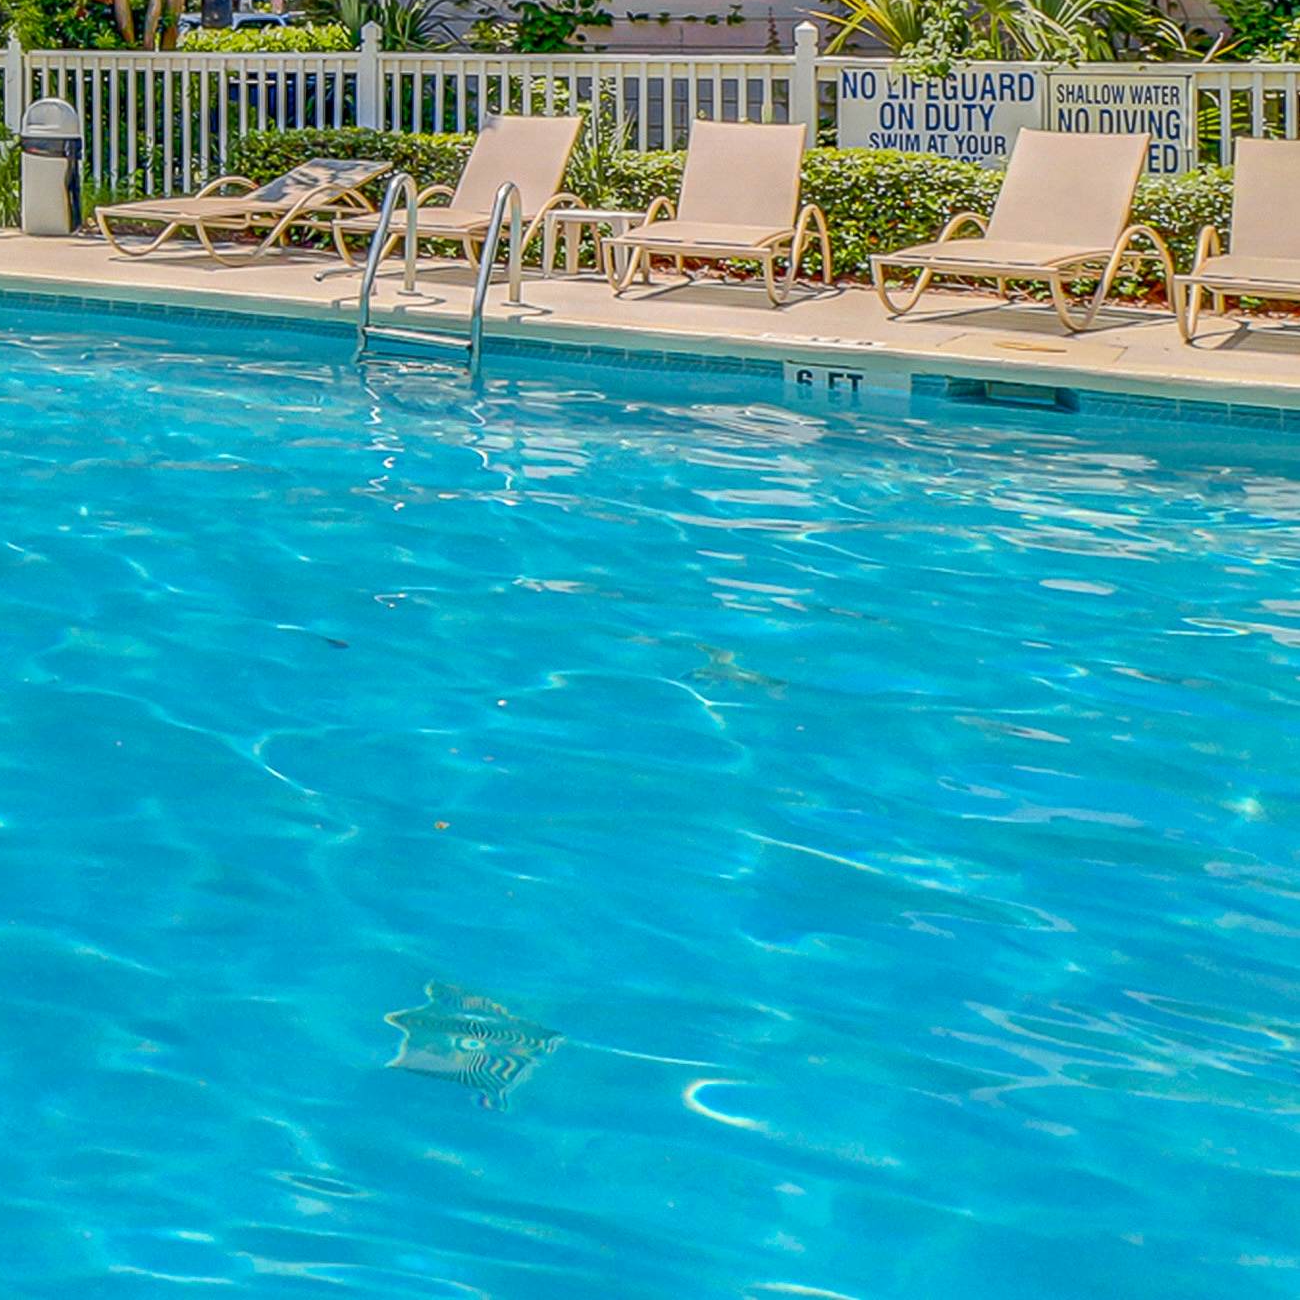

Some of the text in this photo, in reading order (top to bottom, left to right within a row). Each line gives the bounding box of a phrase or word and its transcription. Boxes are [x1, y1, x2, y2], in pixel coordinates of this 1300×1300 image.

[841, 71, 877, 99] NO
[1056, 83, 1180, 106] SHALLOW WATER
[879, 102, 996, 132] ON DUTY
[1058, 108, 1181, 140] NO DIVING
[869, 133, 1007, 156] SWIM AT YOUR
[796, 369, 864, 393] 6 FT
